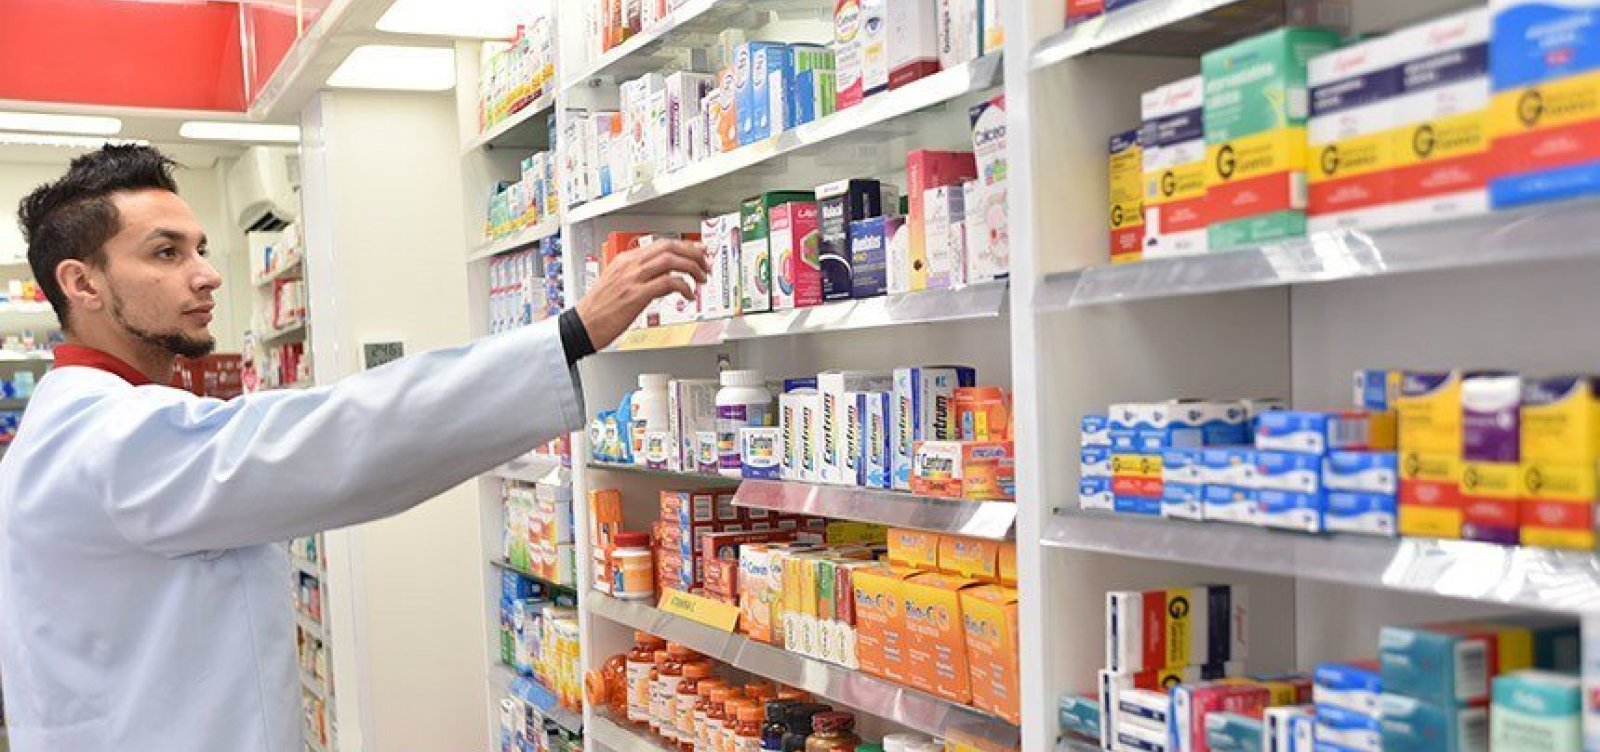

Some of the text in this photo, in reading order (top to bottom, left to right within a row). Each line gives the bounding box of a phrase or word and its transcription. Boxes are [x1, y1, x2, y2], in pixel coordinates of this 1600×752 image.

[1217, 145, 1236, 178] G
[1161, 171, 1175, 197] G
[1112, 205, 1123, 226] G
[782, 405, 792, 468] Centrum
[823, 392, 834, 464] Centrum
[846, 405, 856, 469] Centrum
[933, 395, 947, 440] ntrum
[802, 406, 812, 470] Centrum
[920, 453, 953, 471] Centrum
[1169, 597, 1189, 619] G
